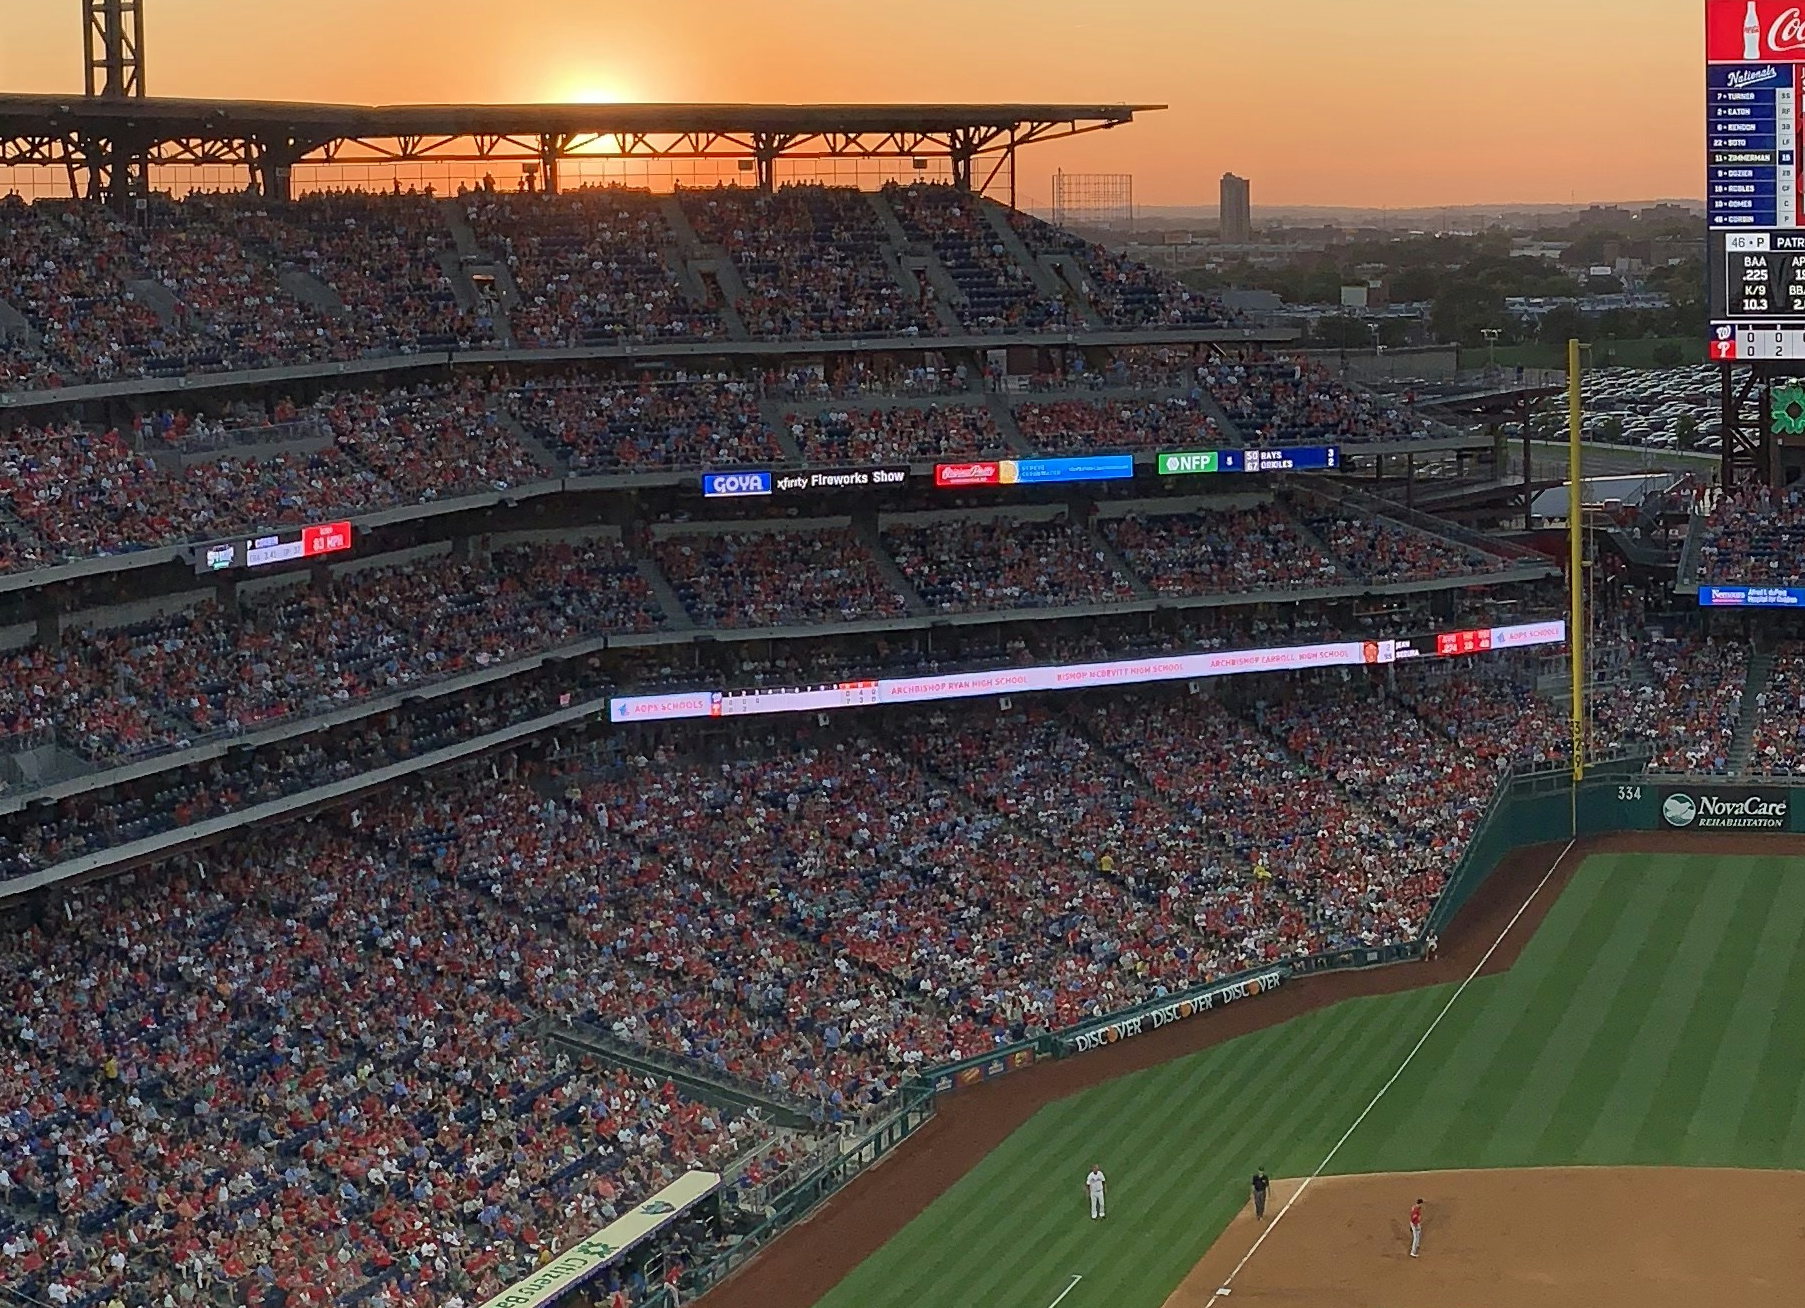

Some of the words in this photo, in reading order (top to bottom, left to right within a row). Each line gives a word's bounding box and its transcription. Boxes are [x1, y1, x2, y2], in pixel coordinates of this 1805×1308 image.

[1731, 238, 1745, 247] 46
[1744, 257, 1766, 267] BAA
[1743, 270, 1768, 281] .225
[1745, 286, 1766, 296] K/9
[1743, 299, 1768, 310] 10.3
[1180, 456, 1211, 470] NFP
[713, 475, 763, 493] GOYA
[811, 473, 868, 488] Fireworks
[873, 470, 905, 483] Show
[995, 675, 1028, 686] SCHOOL
[1617, 786, 1641, 801] 334
[1697, 796, 1784, 817] NovaCare
[1699, 818, 1783, 828] REHABILITATION
